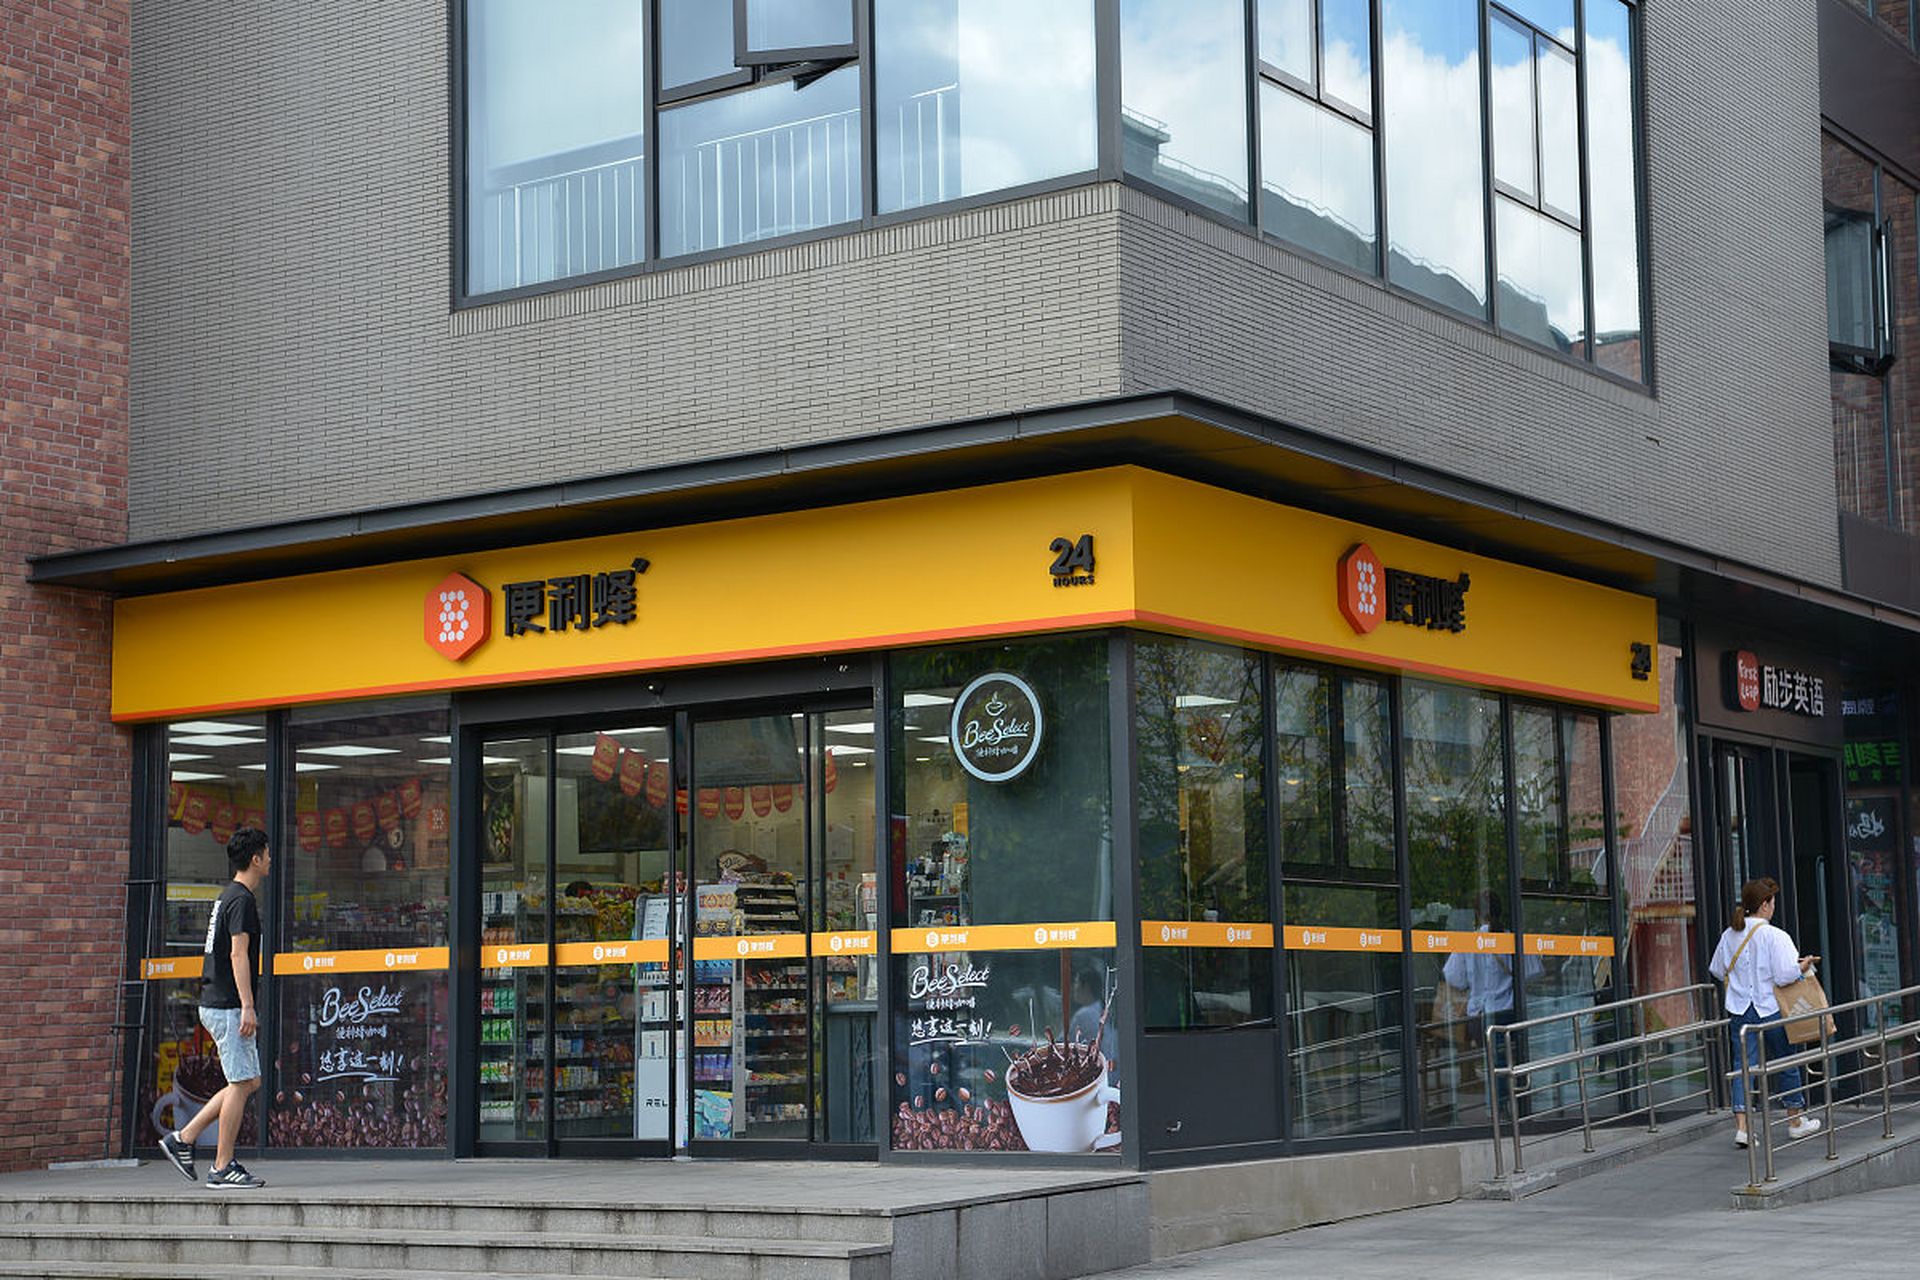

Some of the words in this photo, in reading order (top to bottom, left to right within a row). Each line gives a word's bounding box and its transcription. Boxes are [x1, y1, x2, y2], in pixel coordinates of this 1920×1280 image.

[1049, 534, 1096, 576] 24
[502, 557, 650, 637] 便利蜂
[1384, 567, 1470, 634] 便利蜂
[1763, 665, 1825, 717] 励步英语
